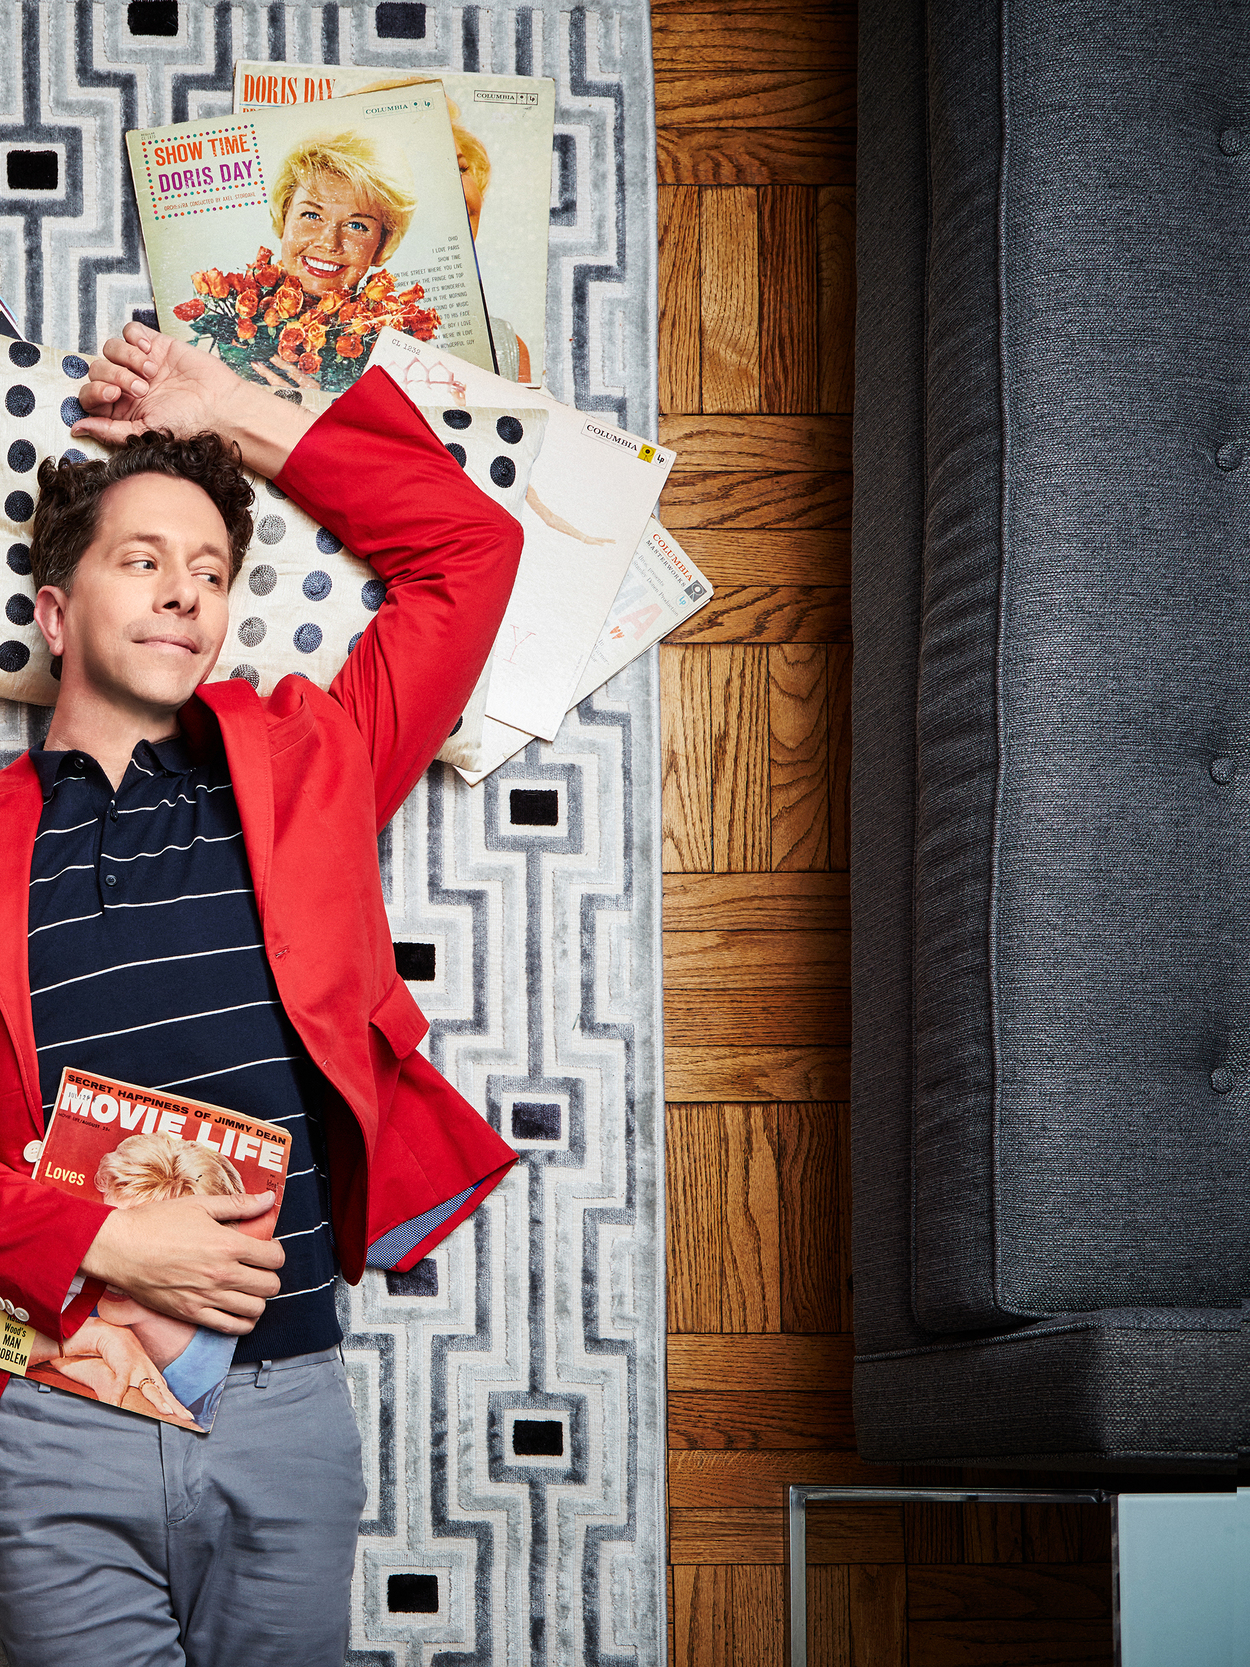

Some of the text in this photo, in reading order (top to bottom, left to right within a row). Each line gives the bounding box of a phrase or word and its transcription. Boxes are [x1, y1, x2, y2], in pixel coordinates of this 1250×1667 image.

[243, 74, 336, 105] DORIS DAY
[476, 92, 516, 101] COLUMBIA
[365, 104, 409, 115] COLUMBIA
[154, 133, 251, 167] SHOW TIME
[158, 160, 253, 193] DORIS DAY
[391, 338, 421, 356] CL 1232
[586, 424, 638, 452] COLUMBIA
[645, 540, 687, 588] MASTERWORKS
[652, 533, 693, 582] COLUMBIA
[67, 1074, 287, 1146] SECRET HAPPINESS OF JIMMY DEAN
[59, 1083, 285, 1173] MOVIE LIFE
[44, 1161, 86, 1187] Loves
[2, 1333, 22, 1350] MAN
[4, 1321, 27, 1338] Wood's
